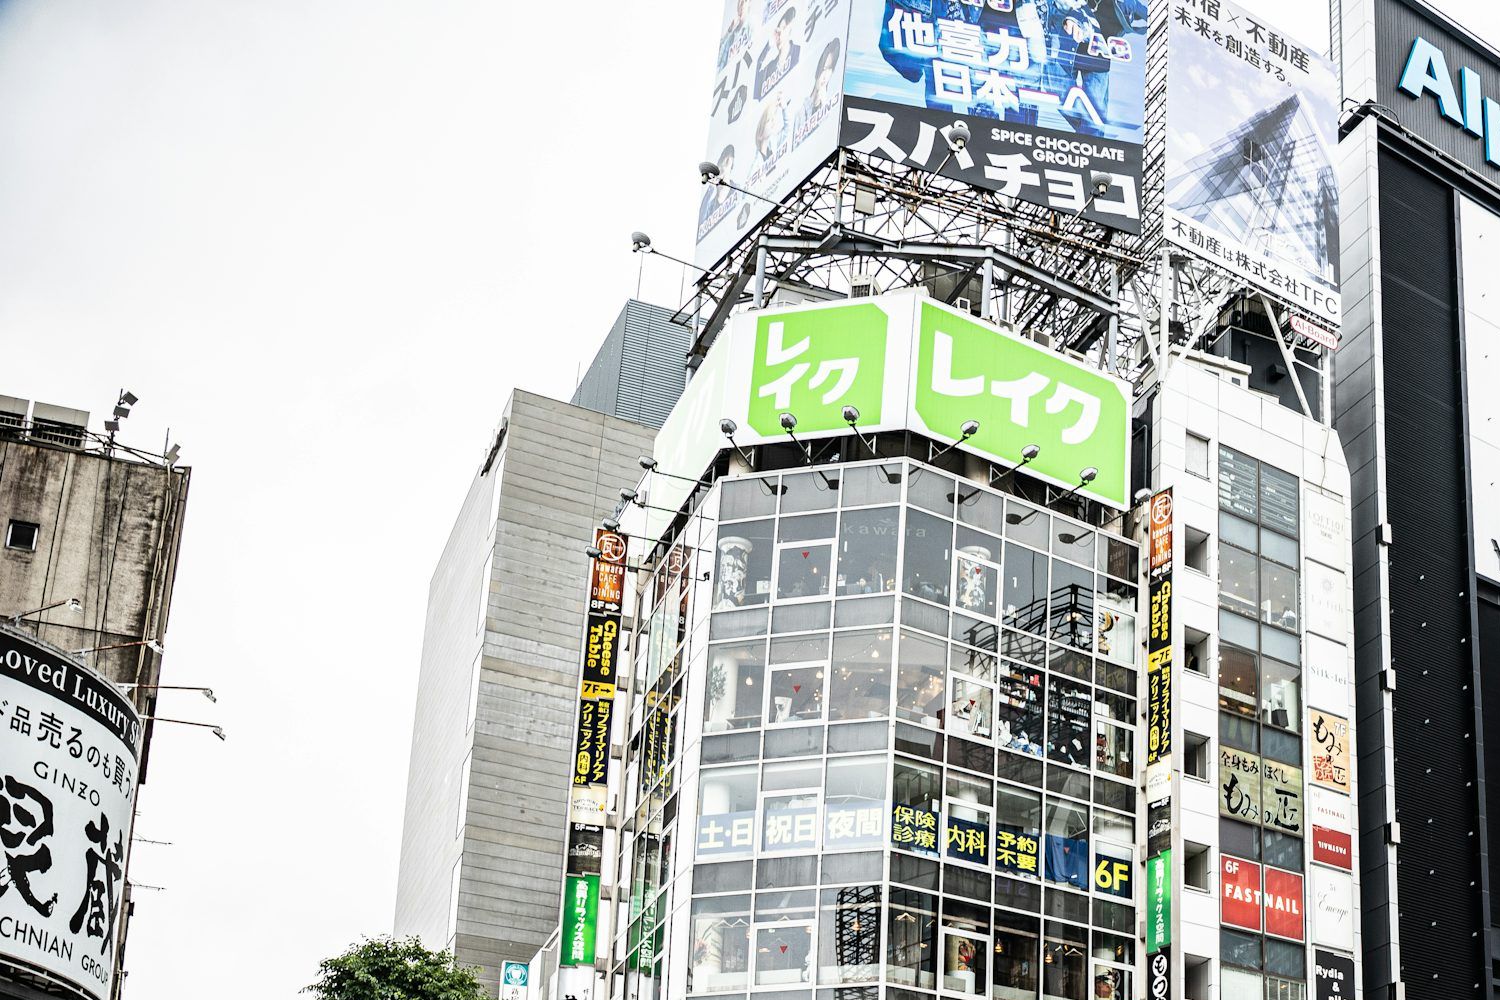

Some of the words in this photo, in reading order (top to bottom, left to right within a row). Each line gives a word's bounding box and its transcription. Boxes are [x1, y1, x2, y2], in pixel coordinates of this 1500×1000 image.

[887, 8, 1030, 71] 他喜力
[1175, 6, 1293, 87] 未来を創造する。
[1245, 17, 1310, 75] 不動産
[932, 60, 1104, 126] 日本一へ
[991, 128, 1032, 147] SPICE
[1035, 135, 1125, 162] CHOCOLATE
[1032, 149, 1090, 169] GROUP
[931, 331, 1102, 446] レイク
[1151, 550, 1172, 566] DINING
[593, 586, 621, 600] DINING
[599, 574, 617, 584] CAFE
[590, 600, 605, 610] 8F
[1151, 590, 1161, 639] Table
[1161, 580, 1171, 641] Cheese
[587, 624, 604, 669] Table
[600, 619, 617, 676] Cheese
[1159, 649, 1171, 663] 7F
[583, 683, 600, 694] 7F
[72, 673, 130, 744] Luxury
[33, 760, 101, 807] GINZO
[1221, 751, 1289, 784] 全身もみほぐし
[893, 805, 936, 831] 保険
[1223, 773, 1300, 832] もみの匠
[766, 815, 818, 844] 祝日
[828, 808, 883, 838] 夜間
[893, 824, 936, 850] 診療
[997, 831, 1037, 851] 予約
[947, 828, 986, 858] 内科
[997, 849, 1037, 872] 不要
[1094, 859, 1129, 889] 6F
[1224, 860, 1240, 875] 6F
[1225, 883, 1299, 915] FASTNAIL
[1332, 982, 1340, 992] &
